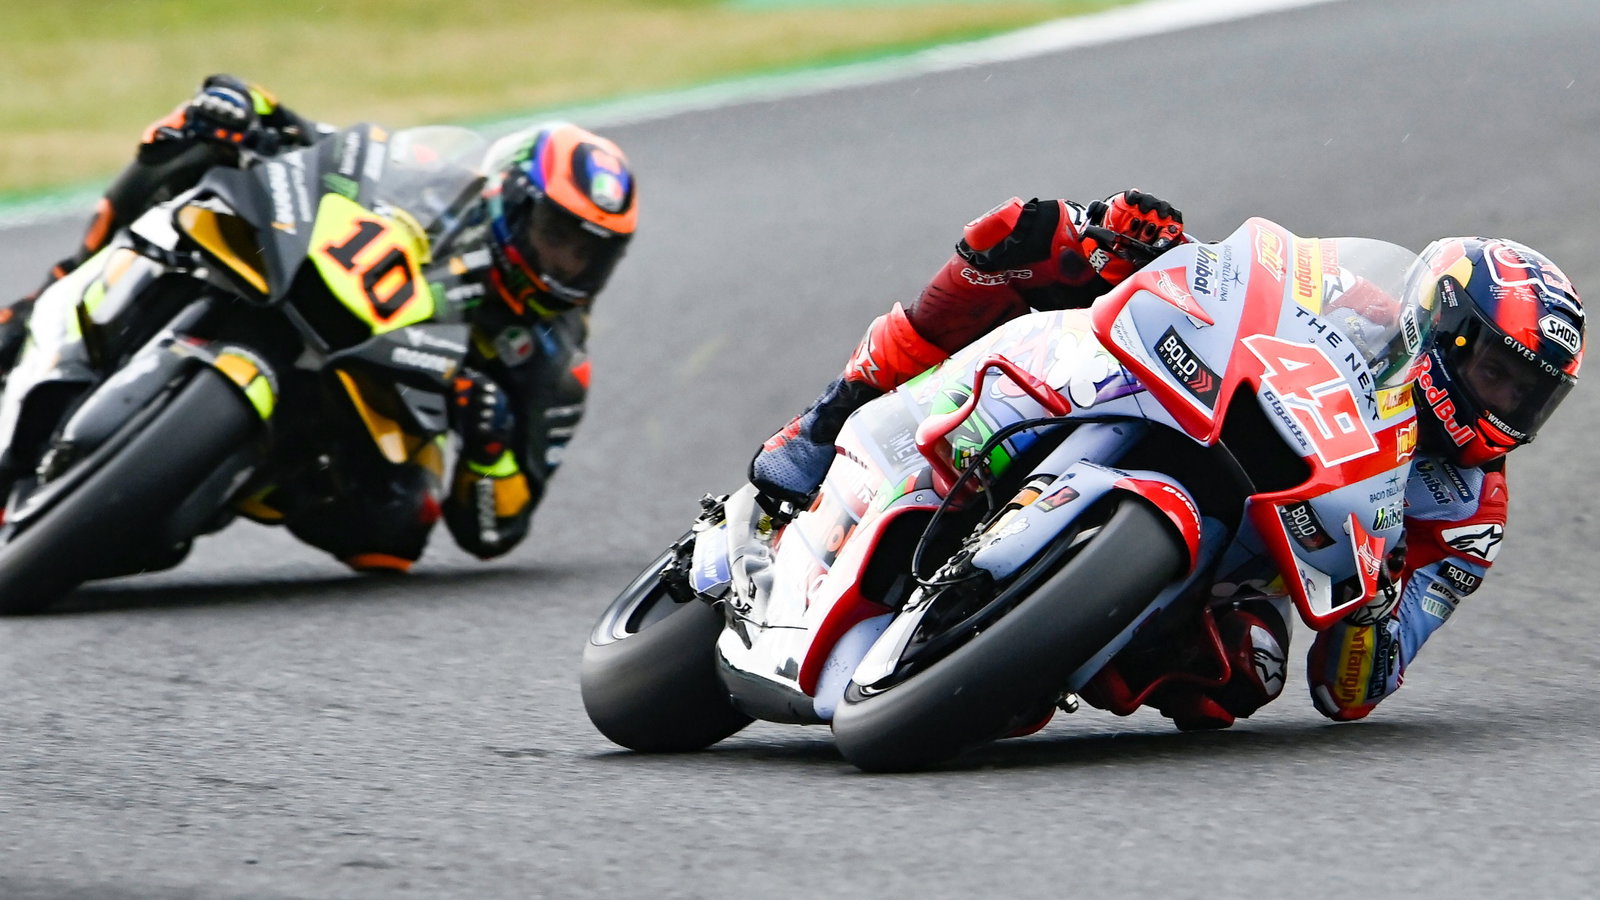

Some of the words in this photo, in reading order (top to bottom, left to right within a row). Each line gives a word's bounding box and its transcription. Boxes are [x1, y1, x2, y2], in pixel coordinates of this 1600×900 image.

[322, 217, 416, 323] 10
[1296, 306, 1343, 348] THE
[1403, 313, 1419, 350] SHOEI
[1547, 319, 1578, 349] SHOEI
[1159, 346, 1189, 383] RIDERS
[1163, 334, 1198, 376] BOLD
[1504, 336, 1537, 361] GIVES
[1540, 359, 1560, 376] YOU
[1240, 334, 1379, 468] 49
[1263, 390, 1308, 451] Gigetta
[1416, 353, 1449, 407] Red
[1433, 398, 1476, 447] Bull
[1291, 505, 1317, 536] BOLD
[1447, 566, 1476, 587] BOLD
